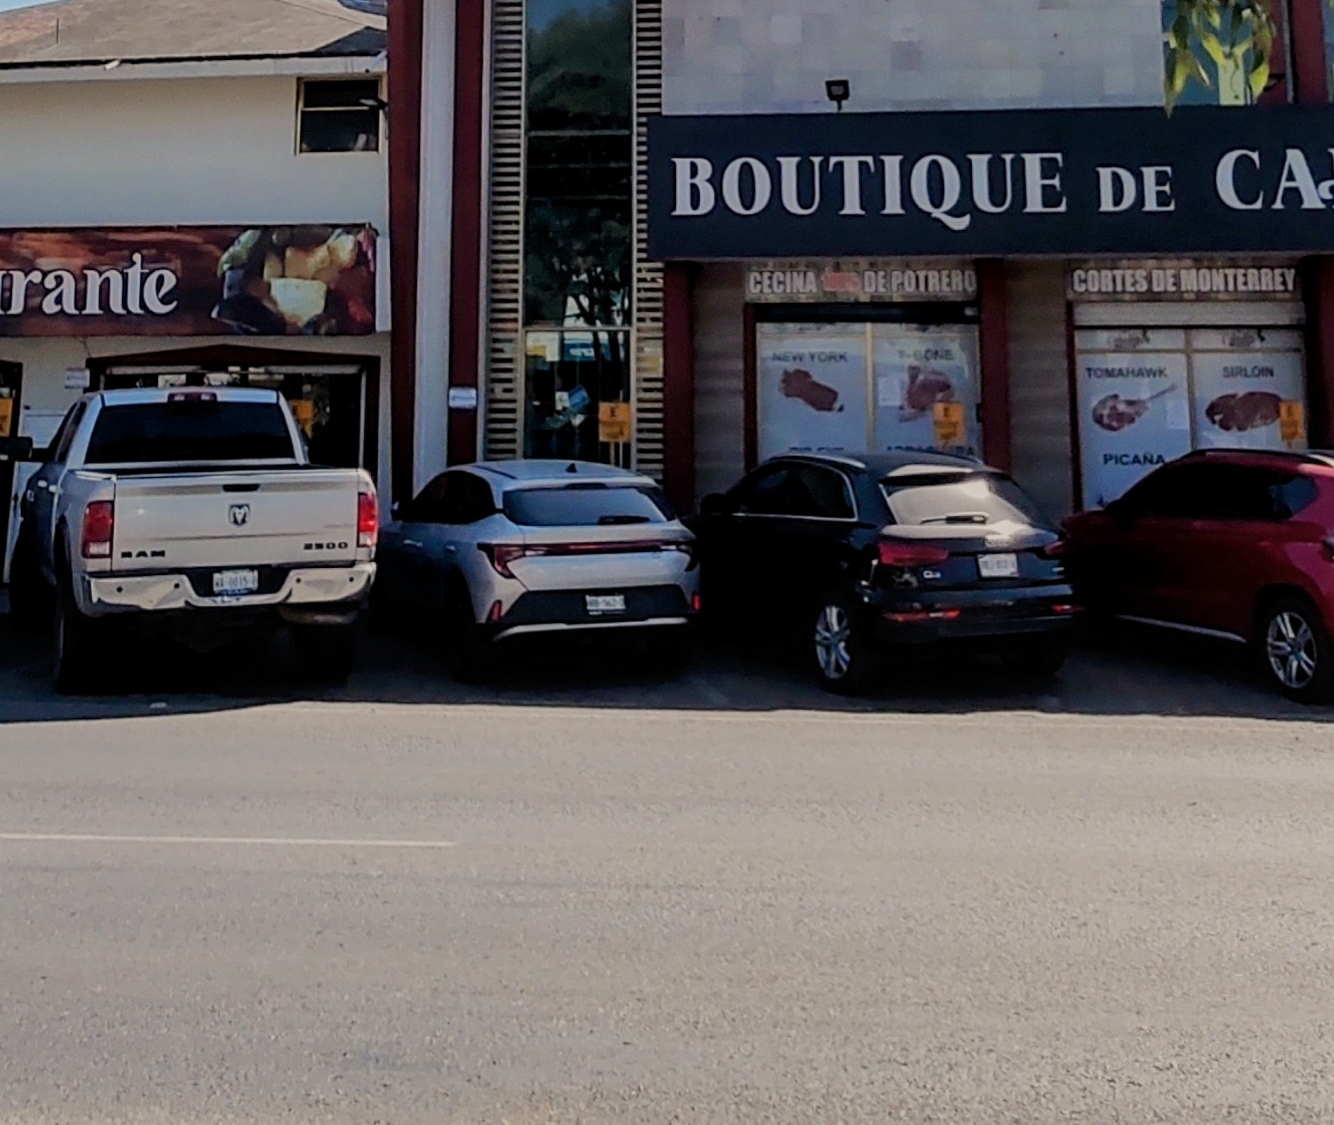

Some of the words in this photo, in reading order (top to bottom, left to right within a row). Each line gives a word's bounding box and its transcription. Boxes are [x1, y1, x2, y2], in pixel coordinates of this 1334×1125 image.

[670, 151, 1066, 231] BOUTIQUE
[1097, 166, 1176, 212] DE
[749, 272, 816, 293] CECINA
[864, 271, 886, 293] DE
[891, 270, 977, 293] POTRERO
[1073, 269, 1148, 292] CORTES
[1151, 269, 1177, 292] DE
[1180, 268, 1295, 291] MONTERREY
[772, 352, 804, 363] NEW
[808, 351, 848, 363] YORK
[1085, 367, 1167, 378] TOMAHAWK
[1104, 452, 1166, 466] PICAÑA
